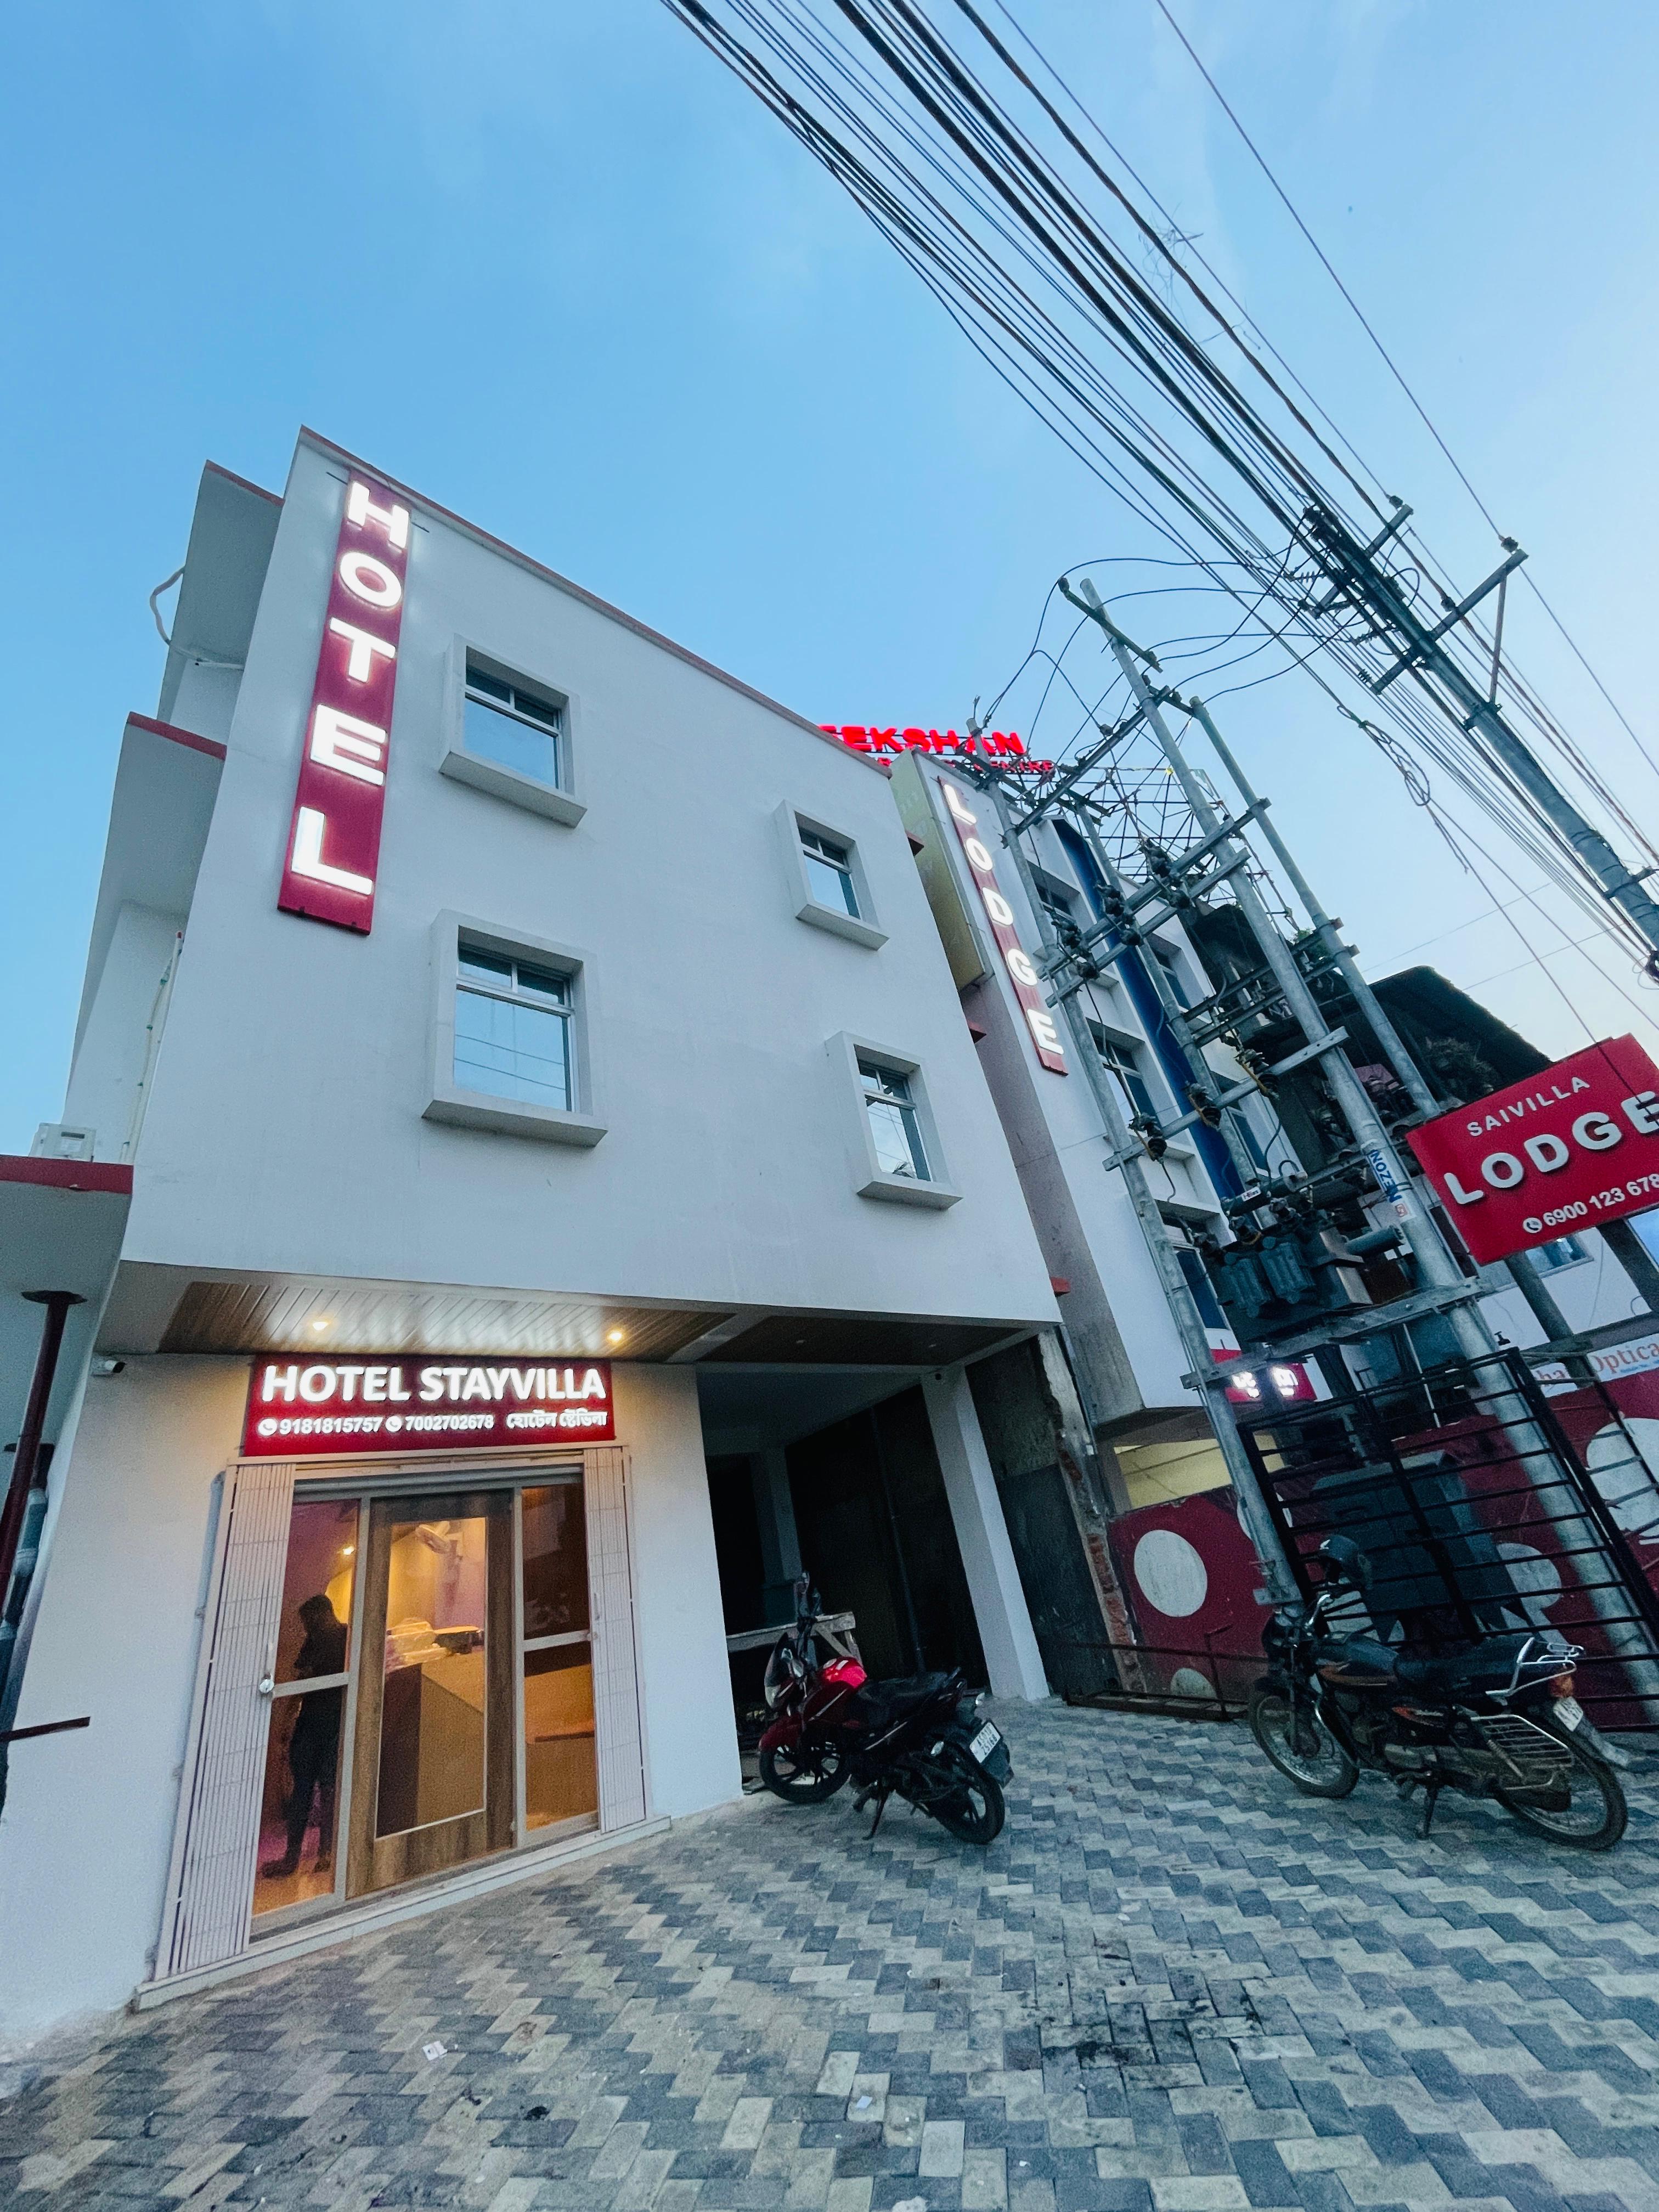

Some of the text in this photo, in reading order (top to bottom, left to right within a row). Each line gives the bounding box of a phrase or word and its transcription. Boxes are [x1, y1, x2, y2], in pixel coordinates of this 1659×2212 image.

[292, 482, 409, 895] HOTEL
[943, 784, 1064, 1055] LODGE
[1467, 1076, 1590, 1137] SAIVILLA
[1443, 1091, 1659, 1205] LODGE
[1543, 1173, 1659, 1226] 6900 123 678
[262, 1365, 607, 1402] HOTEL STAYVILLA
[279, 1414, 495, 1435] 9181815757 7002702678
